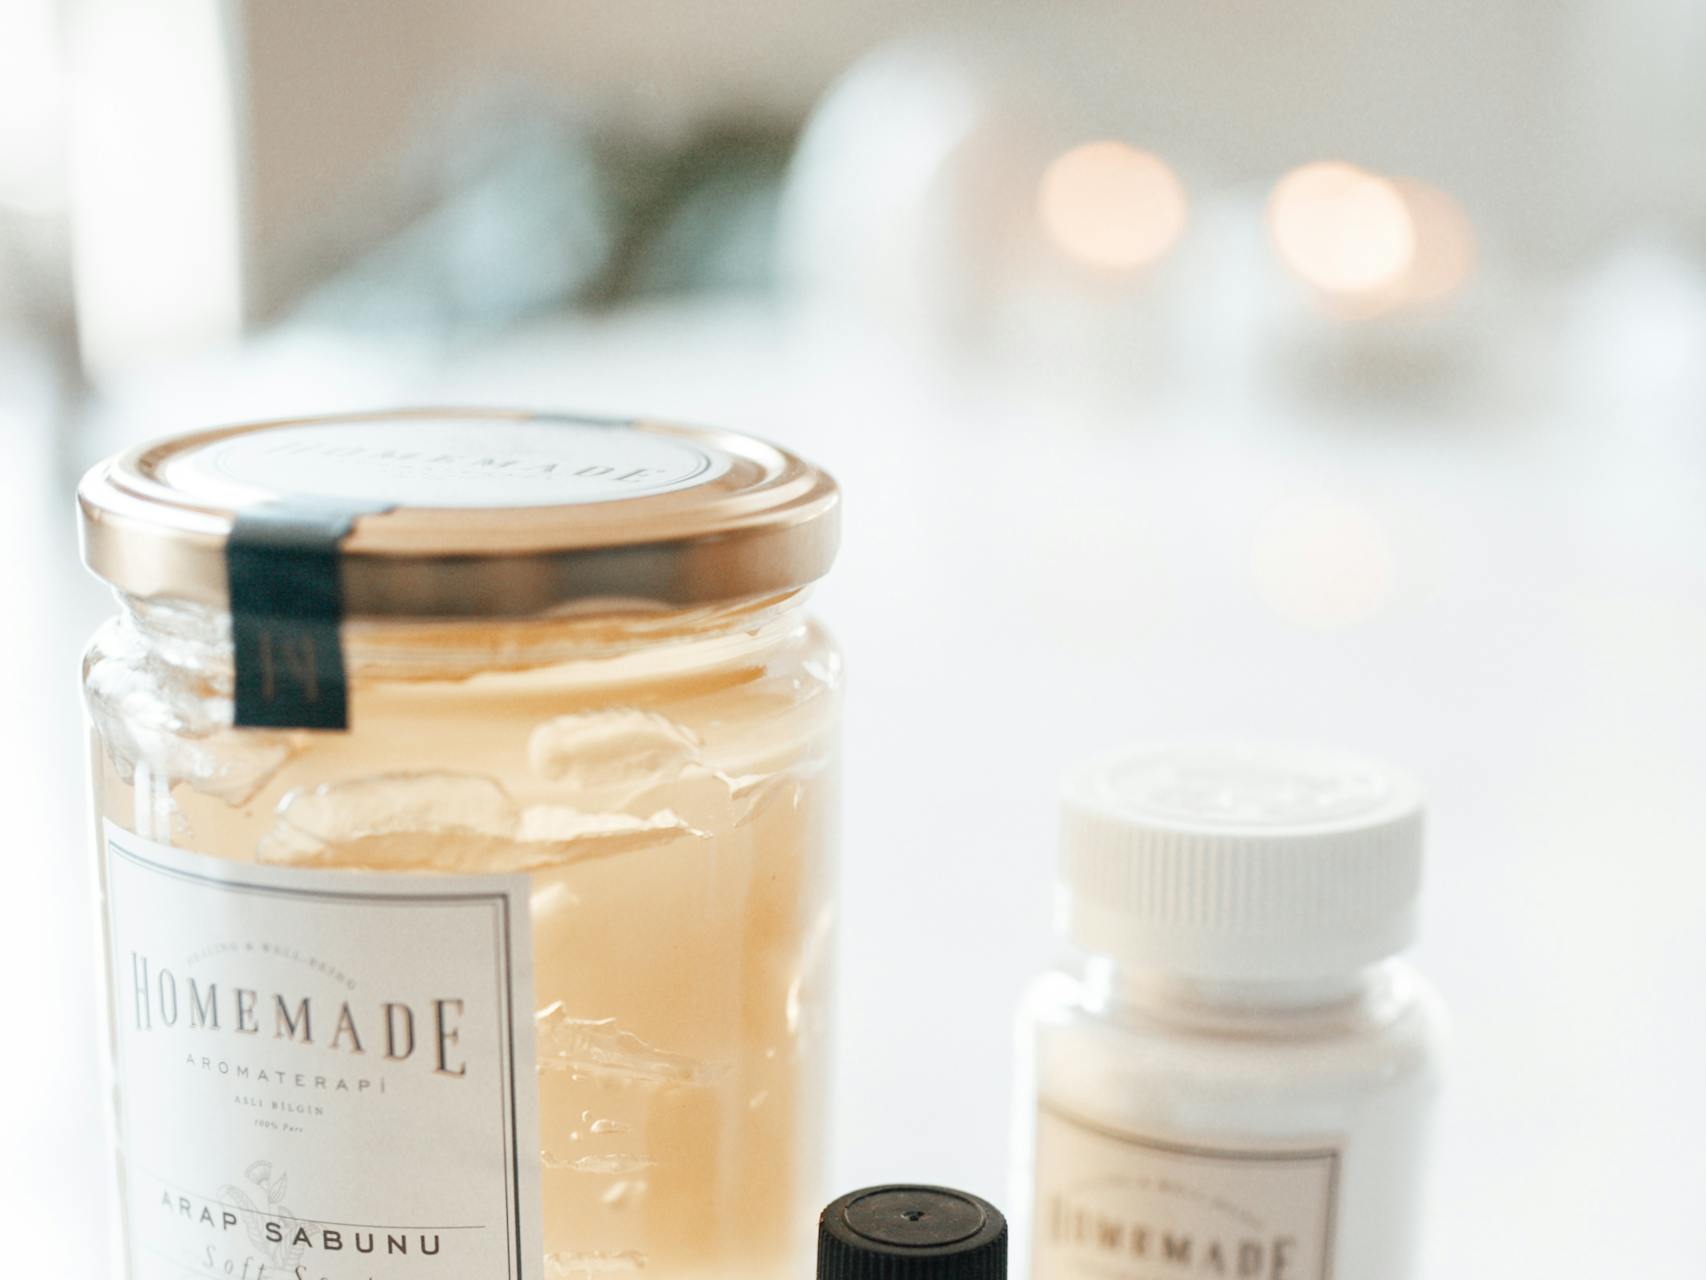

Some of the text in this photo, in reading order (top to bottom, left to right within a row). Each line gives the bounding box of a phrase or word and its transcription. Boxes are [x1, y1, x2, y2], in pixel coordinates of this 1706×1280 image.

[132, 951, 467, 1078] HOMEMADE
[161, 1190, 440, 1256] ARAP SABUNU
